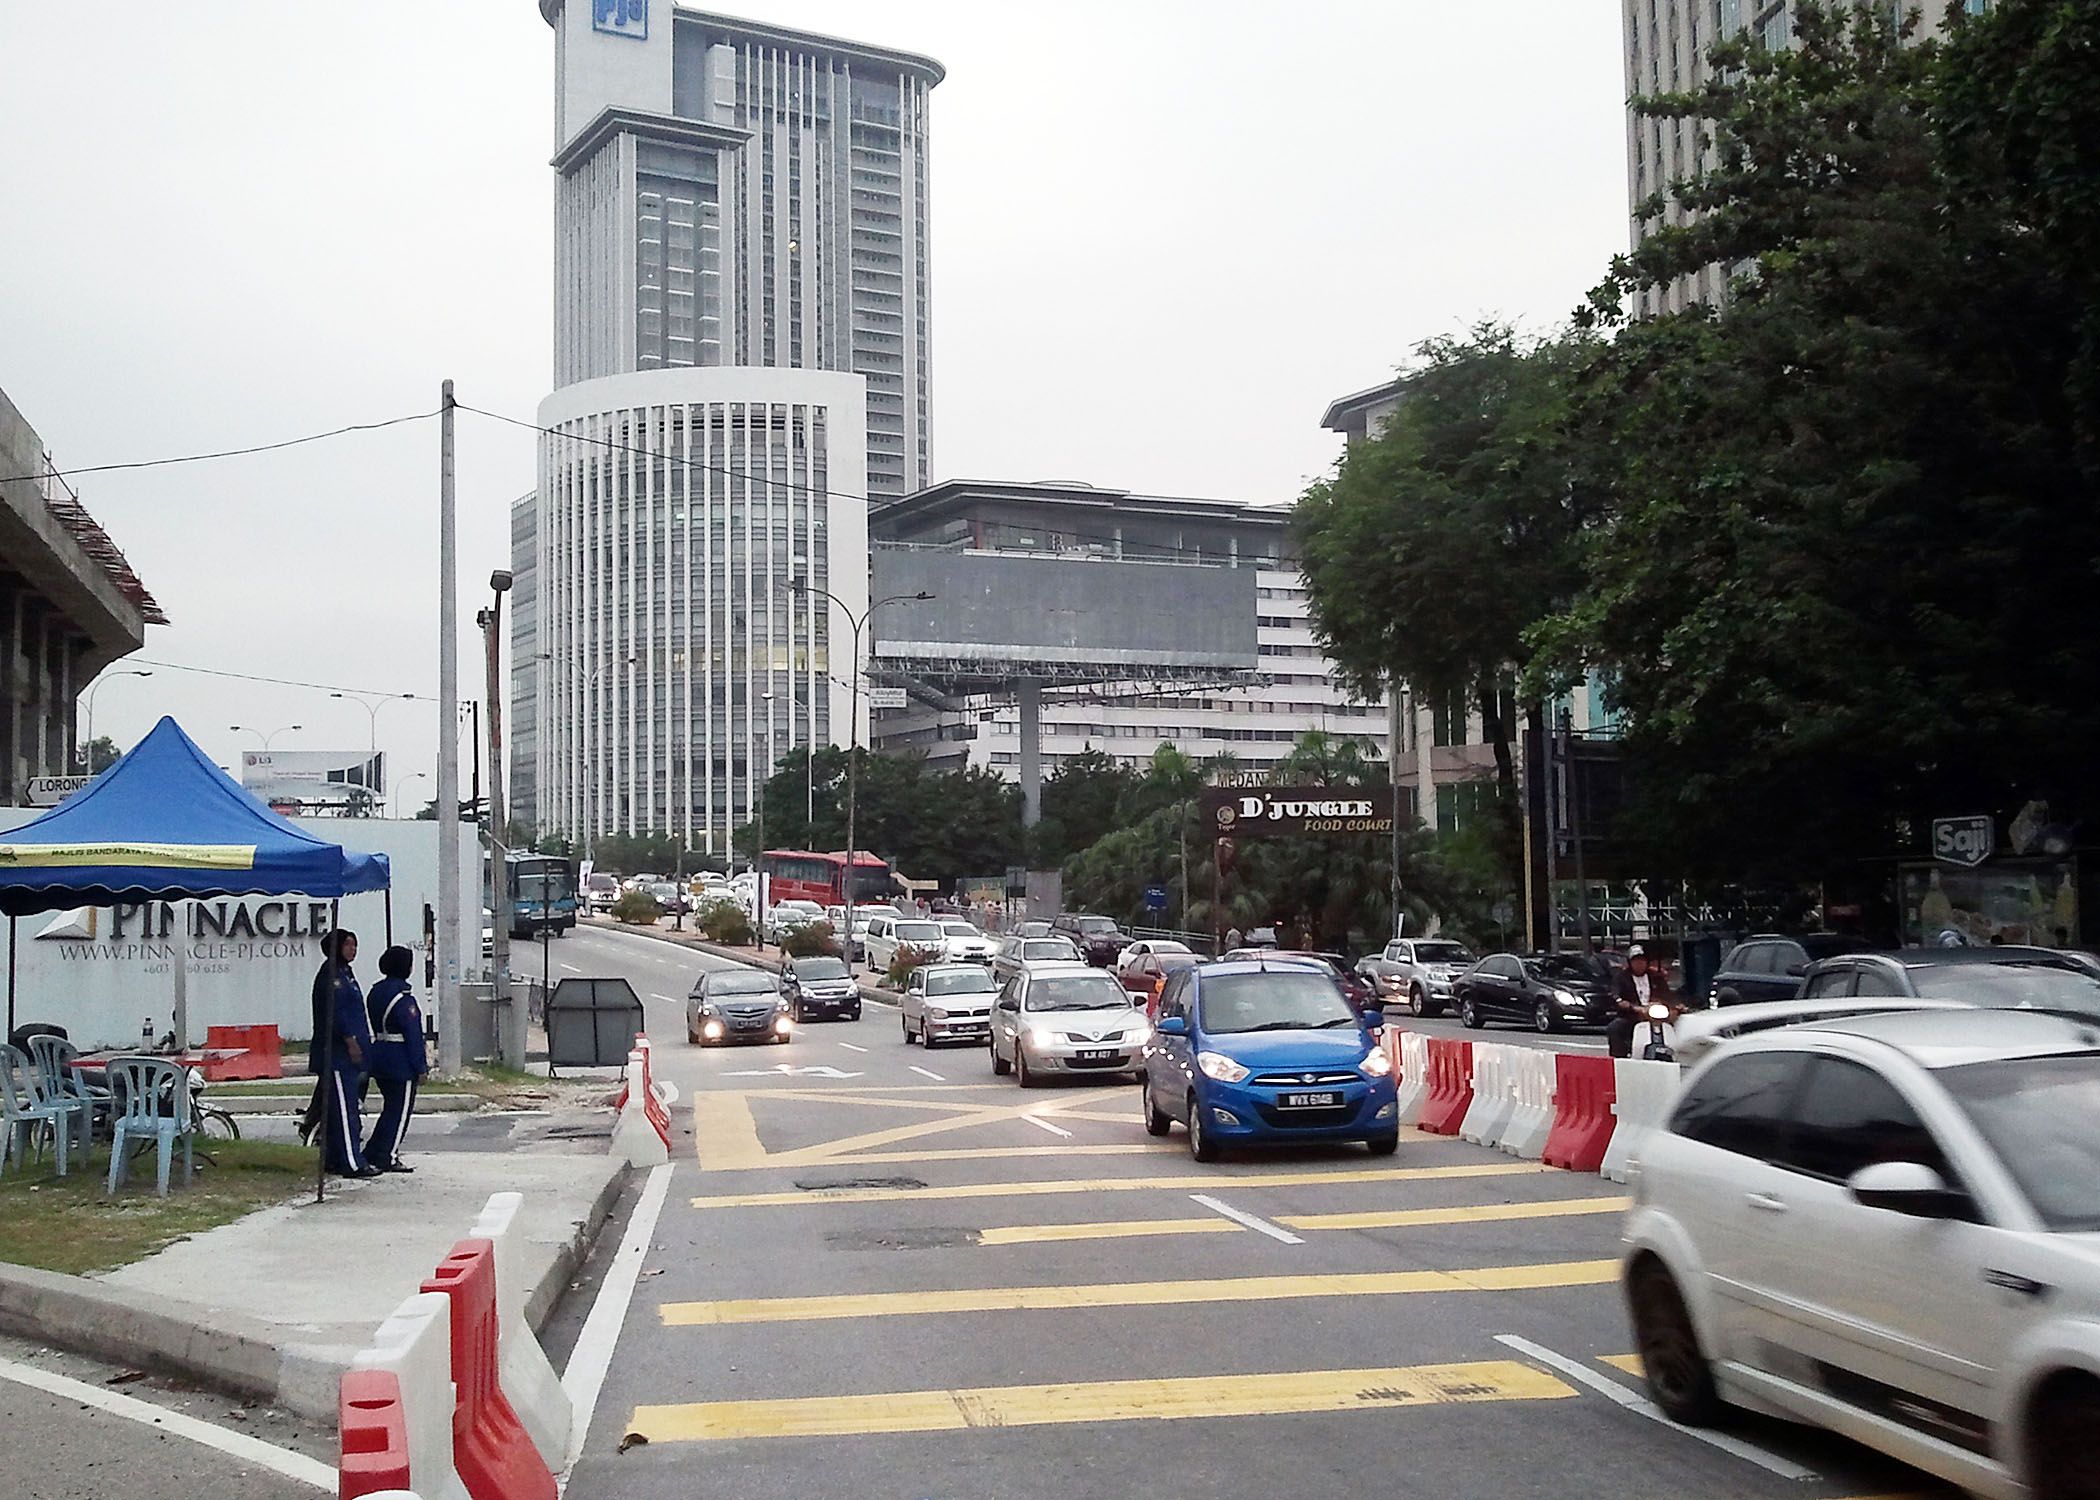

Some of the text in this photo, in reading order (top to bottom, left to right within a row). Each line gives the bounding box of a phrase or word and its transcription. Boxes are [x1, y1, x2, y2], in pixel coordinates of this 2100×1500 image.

[40, 778, 88, 792] LORONG
[1239, 793, 1373, 820] D'JUNGLE
[1304, 818, 1392, 831] FOOD COURT
[1937, 820, 1985, 861] Saji
[86, 847, 142, 856] BANDARAYA
[110, 901, 328, 939] PINNACLE
